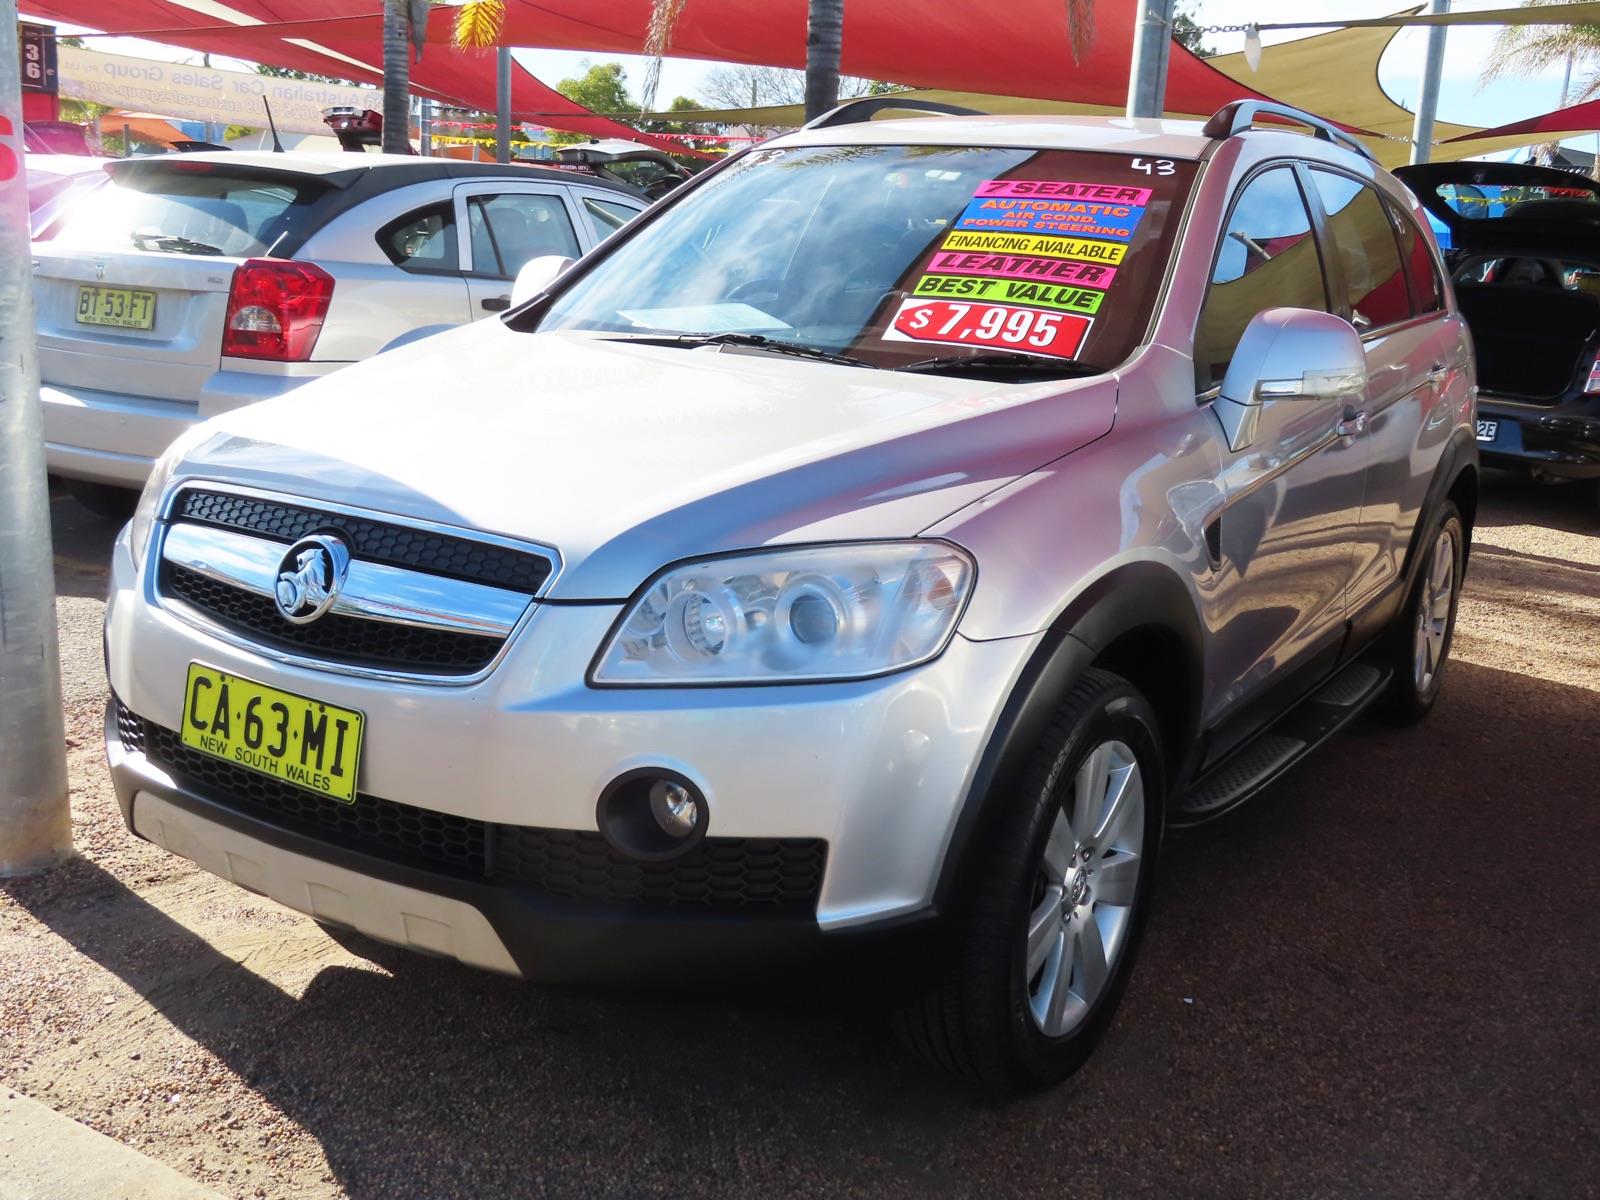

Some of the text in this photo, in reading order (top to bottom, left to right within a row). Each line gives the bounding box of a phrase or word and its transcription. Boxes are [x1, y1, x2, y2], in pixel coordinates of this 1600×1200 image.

[1131, 157, 1176, 176] 43
[987, 182, 1142, 201] 7 SEATER
[981, 199, 1130, 218] AUTOMATIC
[1002, 211, 1097, 224] AIR COND.
[962, 218, 1131, 238] POWER STEERING
[946, 234, 1122, 261] FINANCING AVAILABLE
[936, 254, 1107, 283] LEATHER
[919, 277, 1099, 308] BEST VALUE
[909, 305, 1061, 346] $ 7,995
[200, 734, 330, 791] NEW SOUTH WALES
